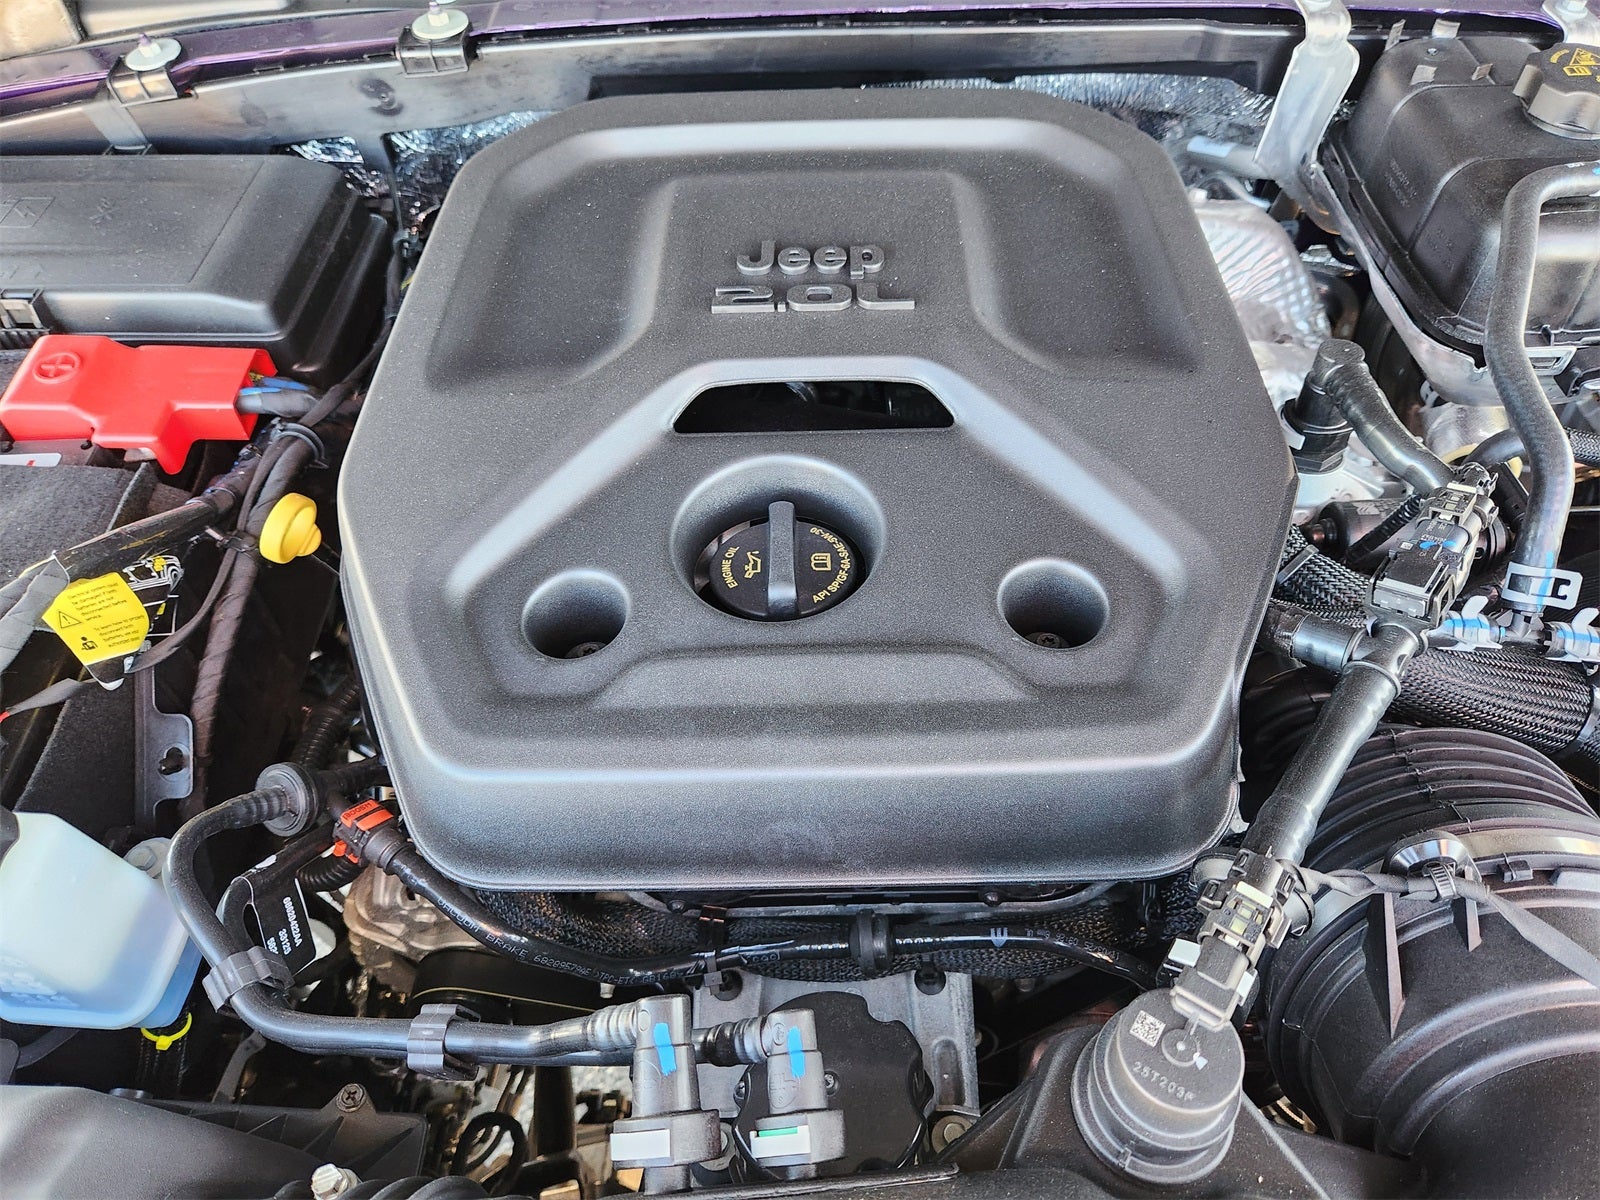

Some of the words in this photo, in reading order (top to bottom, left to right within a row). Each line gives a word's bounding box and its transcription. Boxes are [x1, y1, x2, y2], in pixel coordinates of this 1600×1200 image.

[737, 240, 885, 279] Jeep
[711, 284, 916, 313] 2.0L
[724, 546, 740, 558] OIL
[721, 559, 739, 589] ENGINE
[812, 589, 831, 603] API
[437, 895, 481, 934] VACUUM
[484, 933, 530, 959] BRAKE
